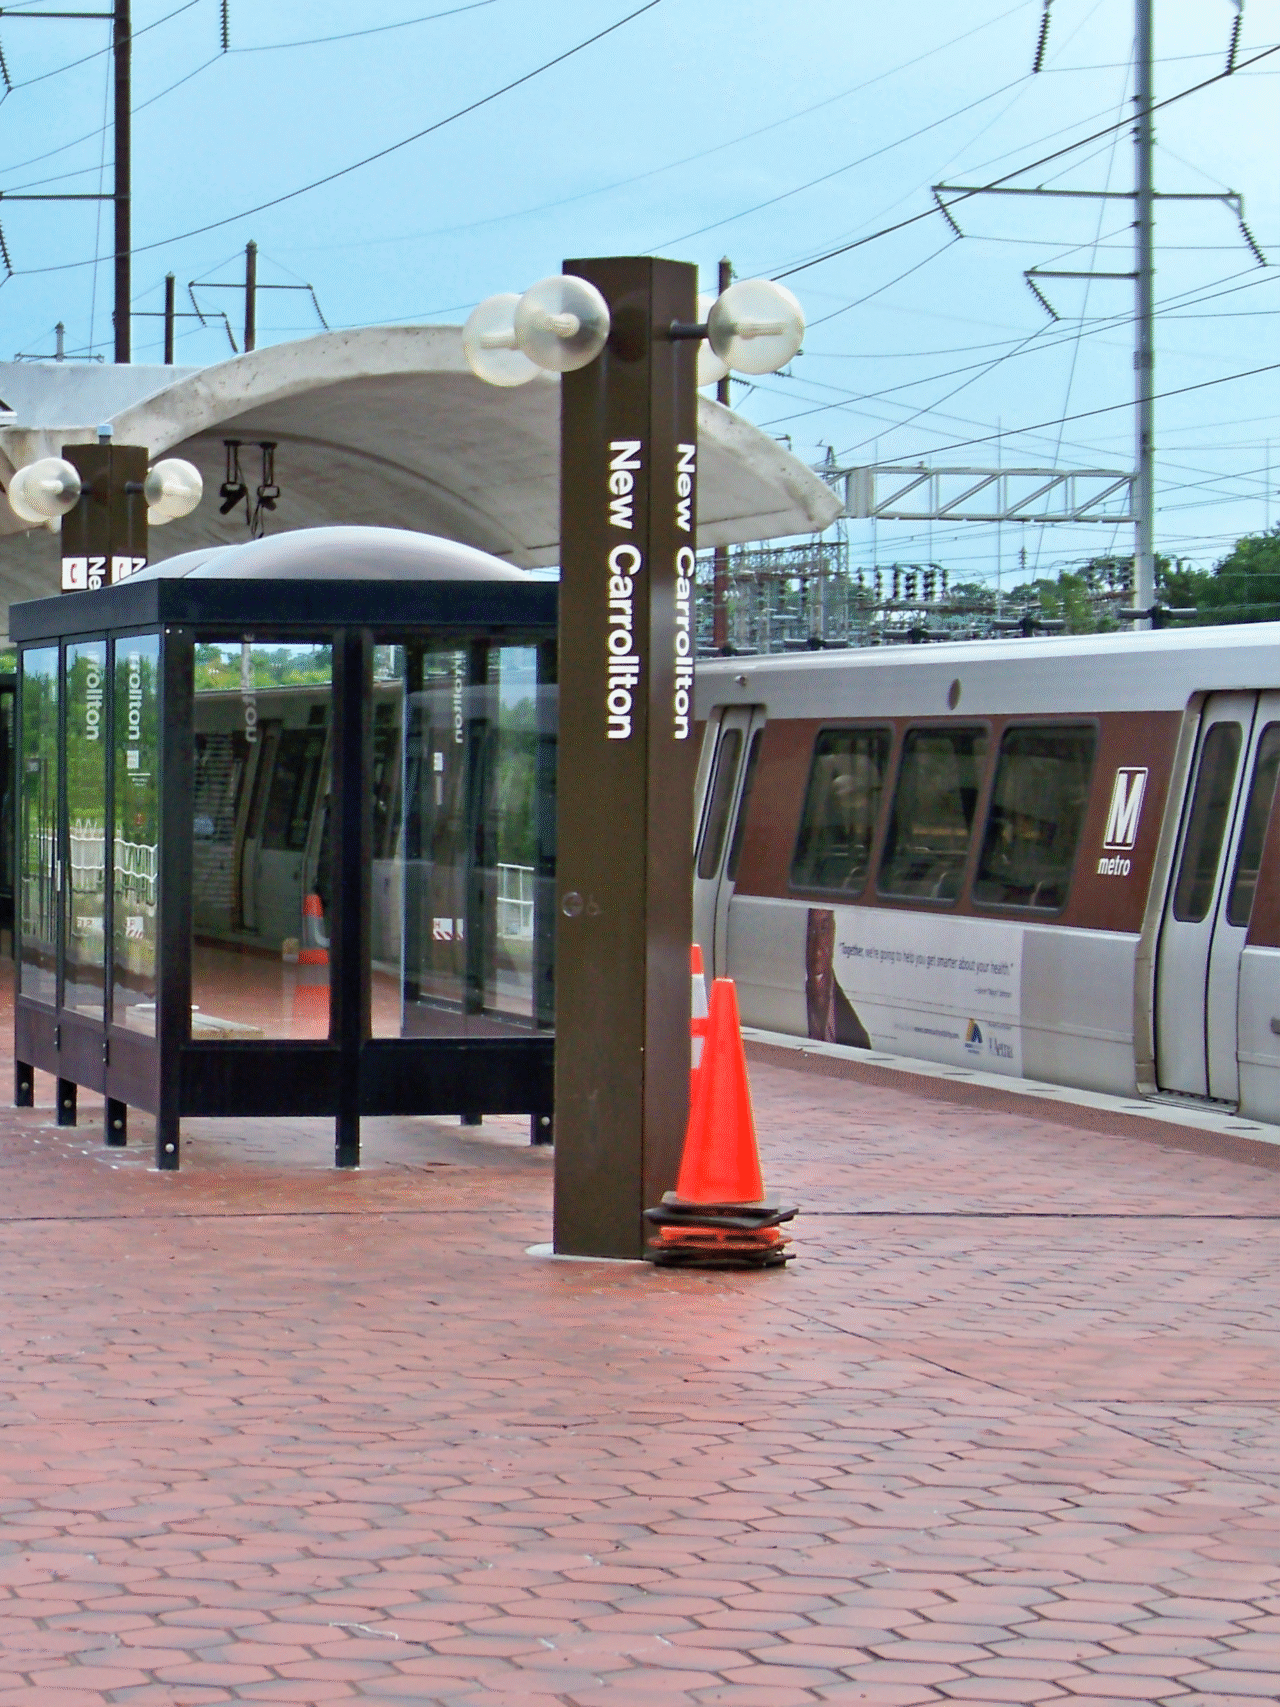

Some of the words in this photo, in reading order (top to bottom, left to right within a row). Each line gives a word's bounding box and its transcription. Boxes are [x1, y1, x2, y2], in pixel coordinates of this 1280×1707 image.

[609, 440, 641, 529] New
[676, 443, 696, 532] New
[88, 556, 106, 590] Ne
[607, 544, 641, 739] Carrollton
[674, 546, 695, 740] Carrollton
[1105, 771, 1146, 845] M
[1097, 855, 1131, 876] metro
